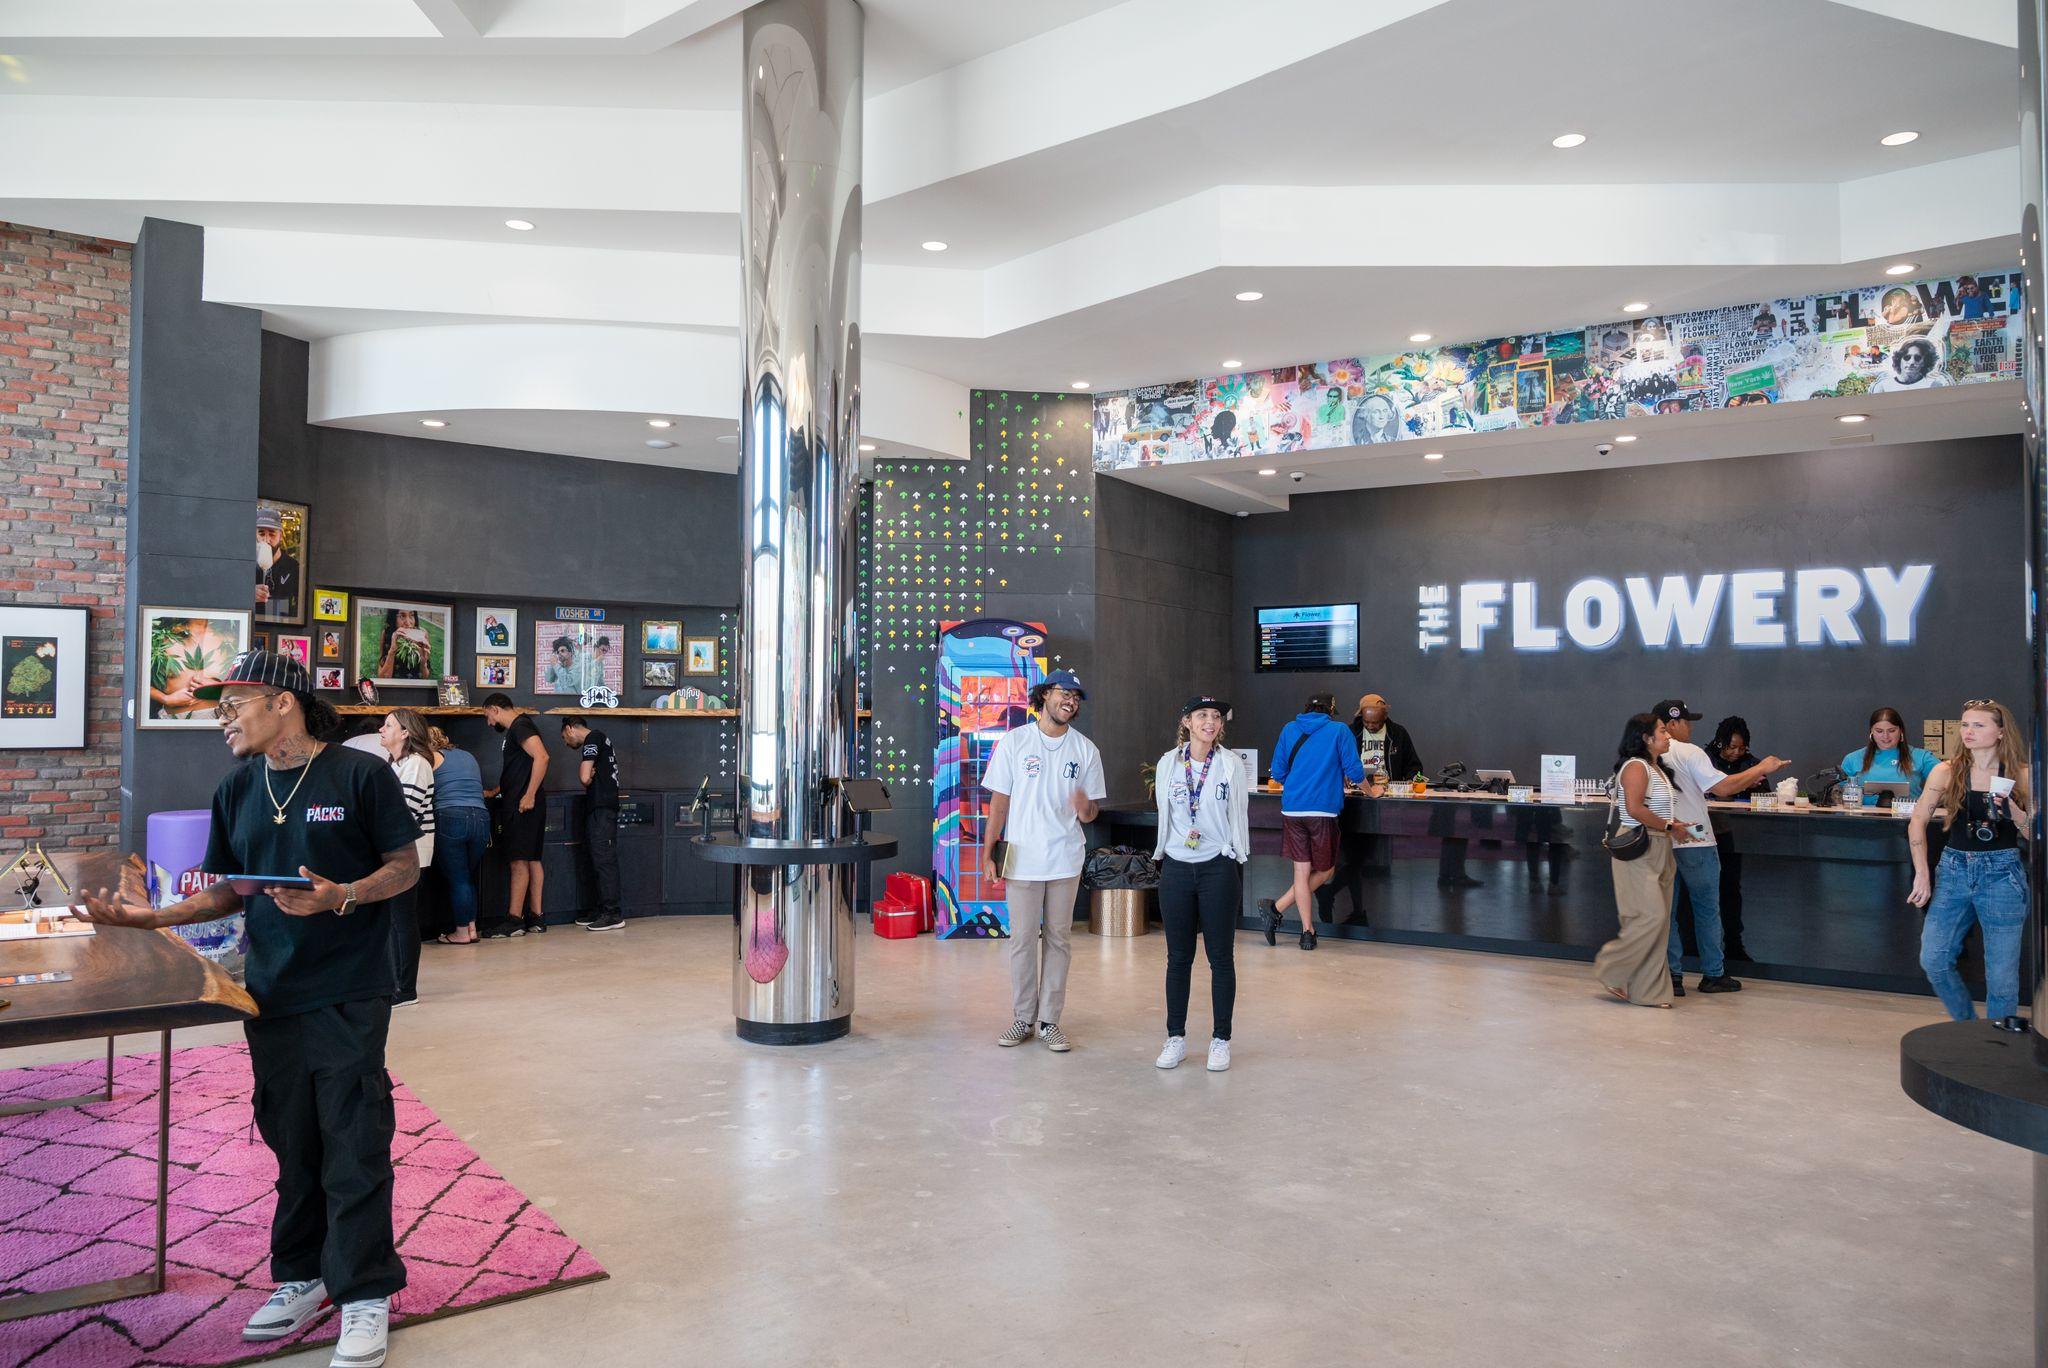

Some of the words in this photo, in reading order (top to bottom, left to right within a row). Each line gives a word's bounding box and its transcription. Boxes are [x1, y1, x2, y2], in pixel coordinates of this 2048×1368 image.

[1683, 309, 1719, 317] FLOWERY
[1723, 304, 1760, 313] FLOWERY
[1676, 315, 1712, 324] FLOWERY
[1790, 300, 1805, 336] THE
[1683, 323, 1720, 332] FLOWERY
[1683, 329, 1720, 338] FLOWERY
[1725, 339, 1763, 349] FLOWERY
[1975, 338, 2003, 346] EARTH
[1728, 348, 1766, 358] FLOWERY
[1974, 347, 2004, 355] MOVED
[1419, 585, 1446, 651] THE
[1460, 565, 1932, 650] FLOWERY
[559, 608, 590, 618] KOSHER
[306, 806, 345, 822] PACKS
